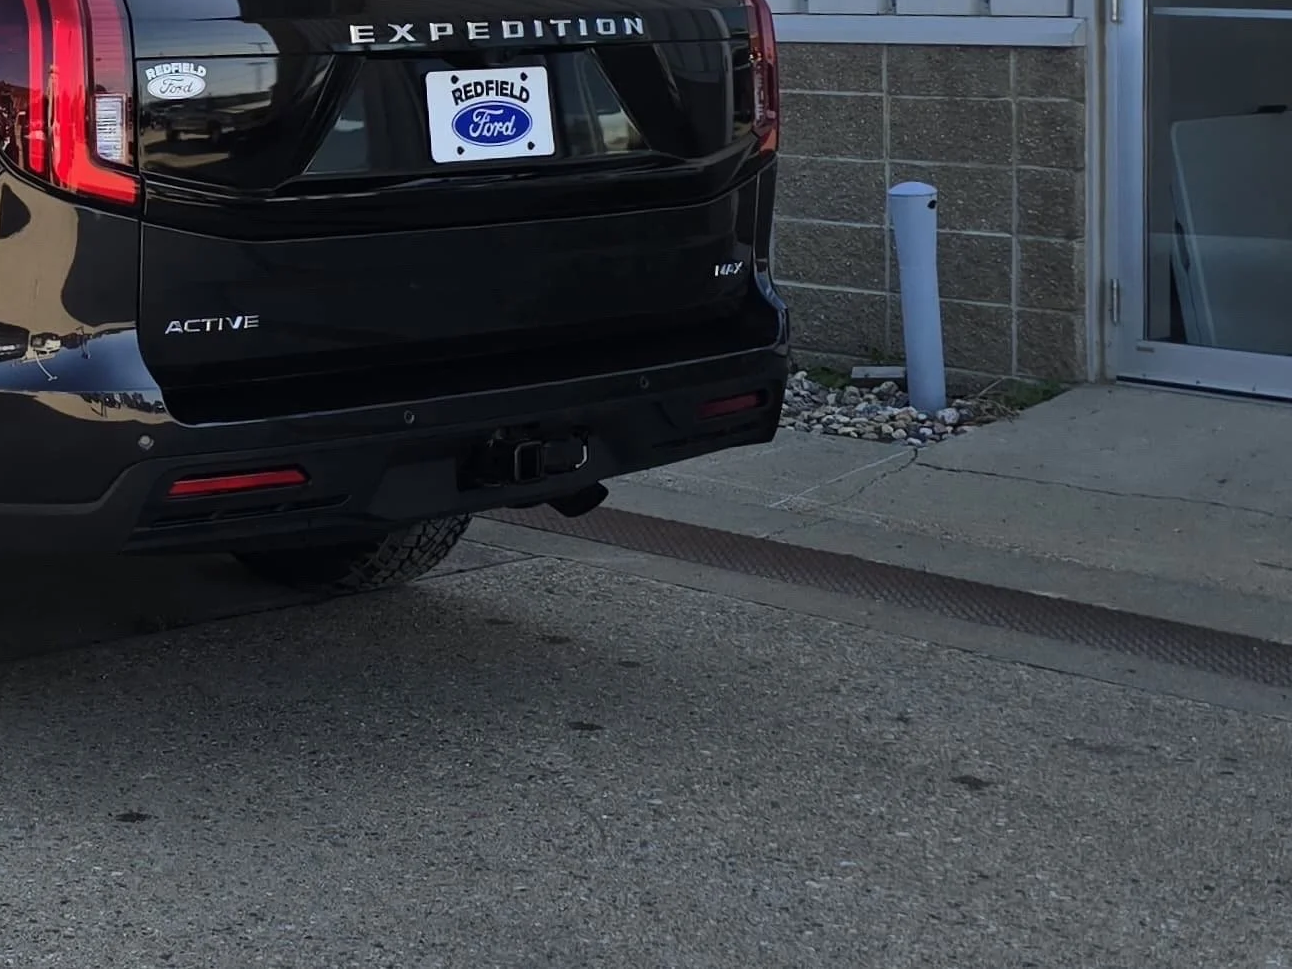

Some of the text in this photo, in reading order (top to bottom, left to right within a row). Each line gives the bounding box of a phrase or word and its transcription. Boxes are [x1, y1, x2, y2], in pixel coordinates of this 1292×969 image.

[349, 17, 645, 44] EXPEDITION
[145, 62, 207, 81] REDFIELD
[159, 77, 194, 94] Ford
[451, 79, 530, 106] REDFIELD
[469, 108, 516, 138] Ford
[164, 314, 260, 335] ACTIVE
